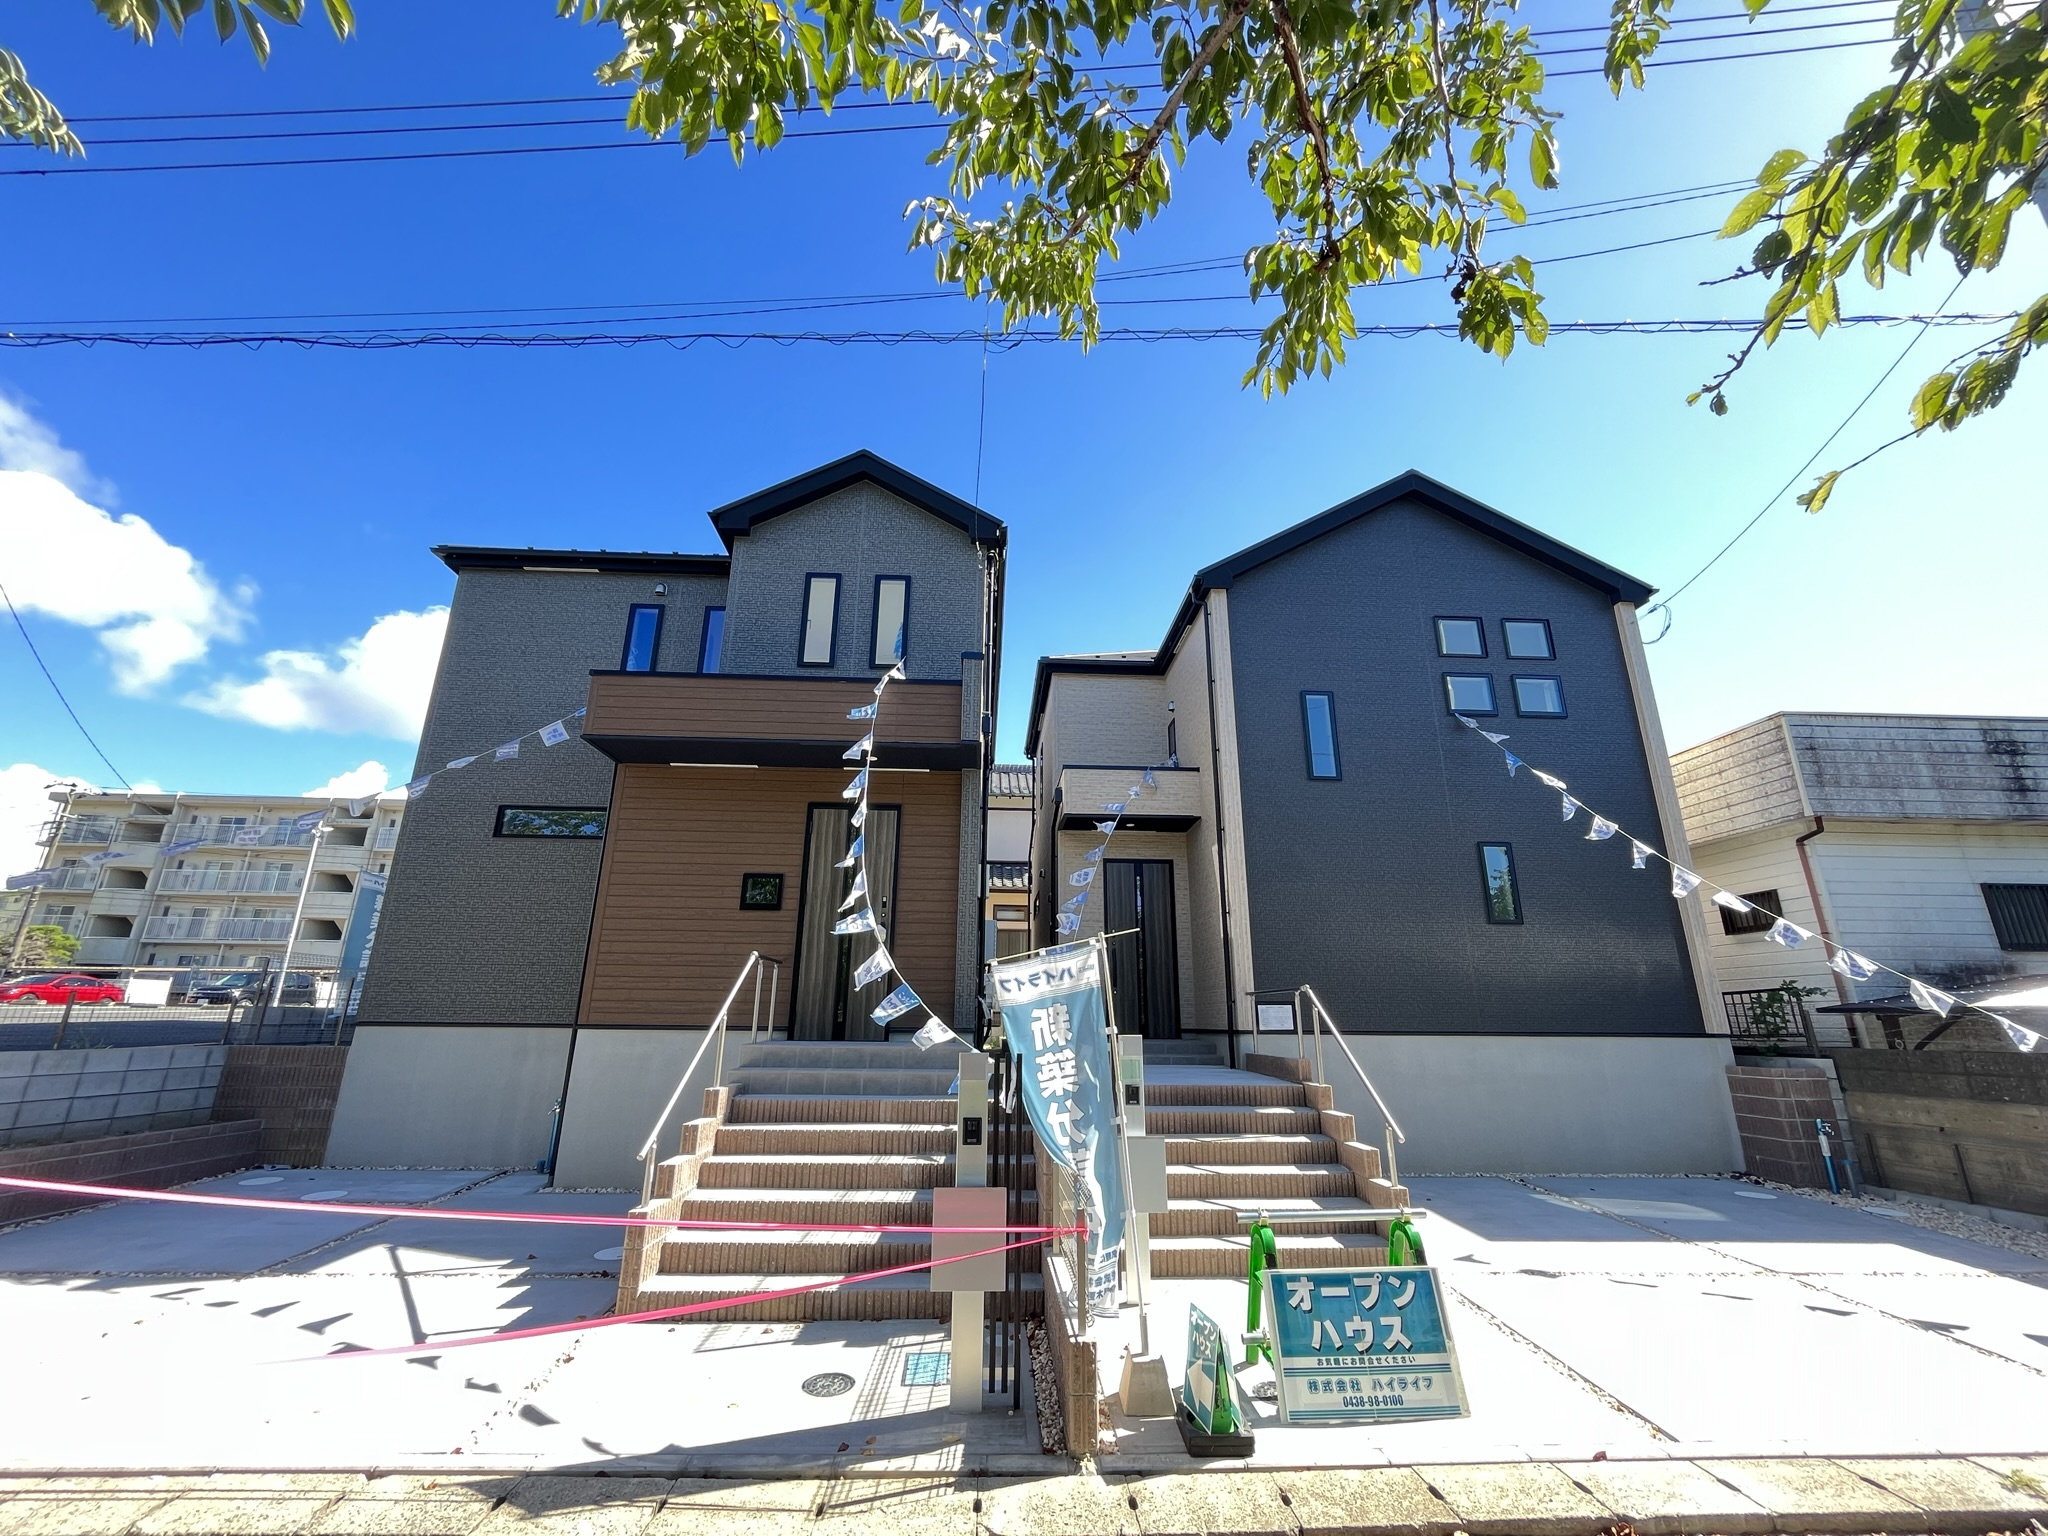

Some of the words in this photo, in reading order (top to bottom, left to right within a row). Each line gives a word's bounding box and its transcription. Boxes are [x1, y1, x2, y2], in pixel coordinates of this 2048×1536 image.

[1286, 1273, 1416, 1312] オープン
[1311, 1315, 1414, 1353] ハウス
[1307, 1378, 1362, 1394] 株式会社
[1371, 1376, 1433, 1392] ハイライフ
[1343, 1394, 1404, 1408] 0438-98-0100
